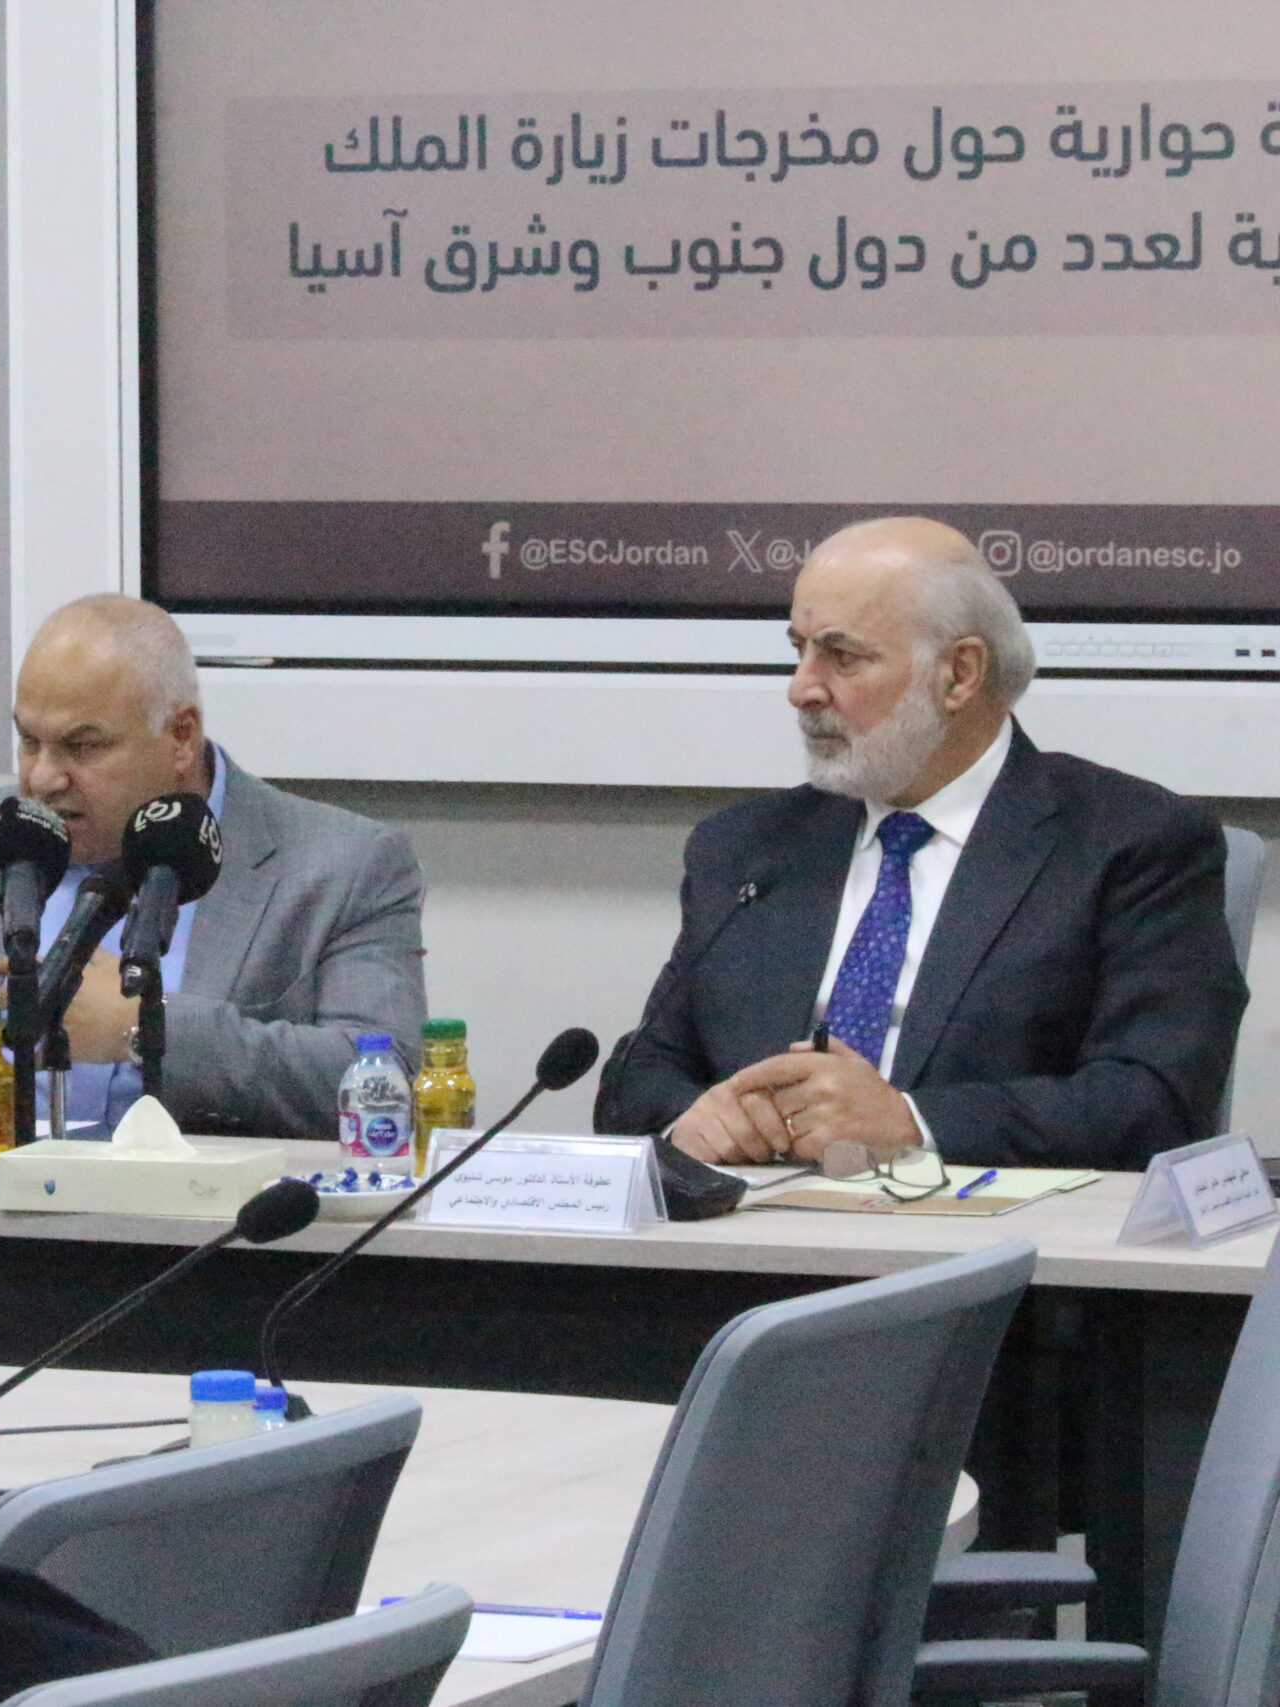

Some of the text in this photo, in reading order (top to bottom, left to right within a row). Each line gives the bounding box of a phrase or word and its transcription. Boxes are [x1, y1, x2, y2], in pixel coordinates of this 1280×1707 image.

[324, 114, 487, 173] الملك
[511, 113, 628, 185] زيارة
[652, 110, 880, 183] مخرجات
[904, 106, 1025, 181] حول
[1050, 103, 1236, 178] حوارية
[290, 209, 409, 293] آسيا
[424, 214, 600, 293] وشرق
[624, 222, 785, 291] جنوب
[808, 216, 927, 291] دول
[951, 230, 1038, 289] من
[1063, 211, 1202, 271] لعدد
[520, 539, 709, 570] @ESCJordan
[1027, 540, 1241, 574] @jordanesc.jo
